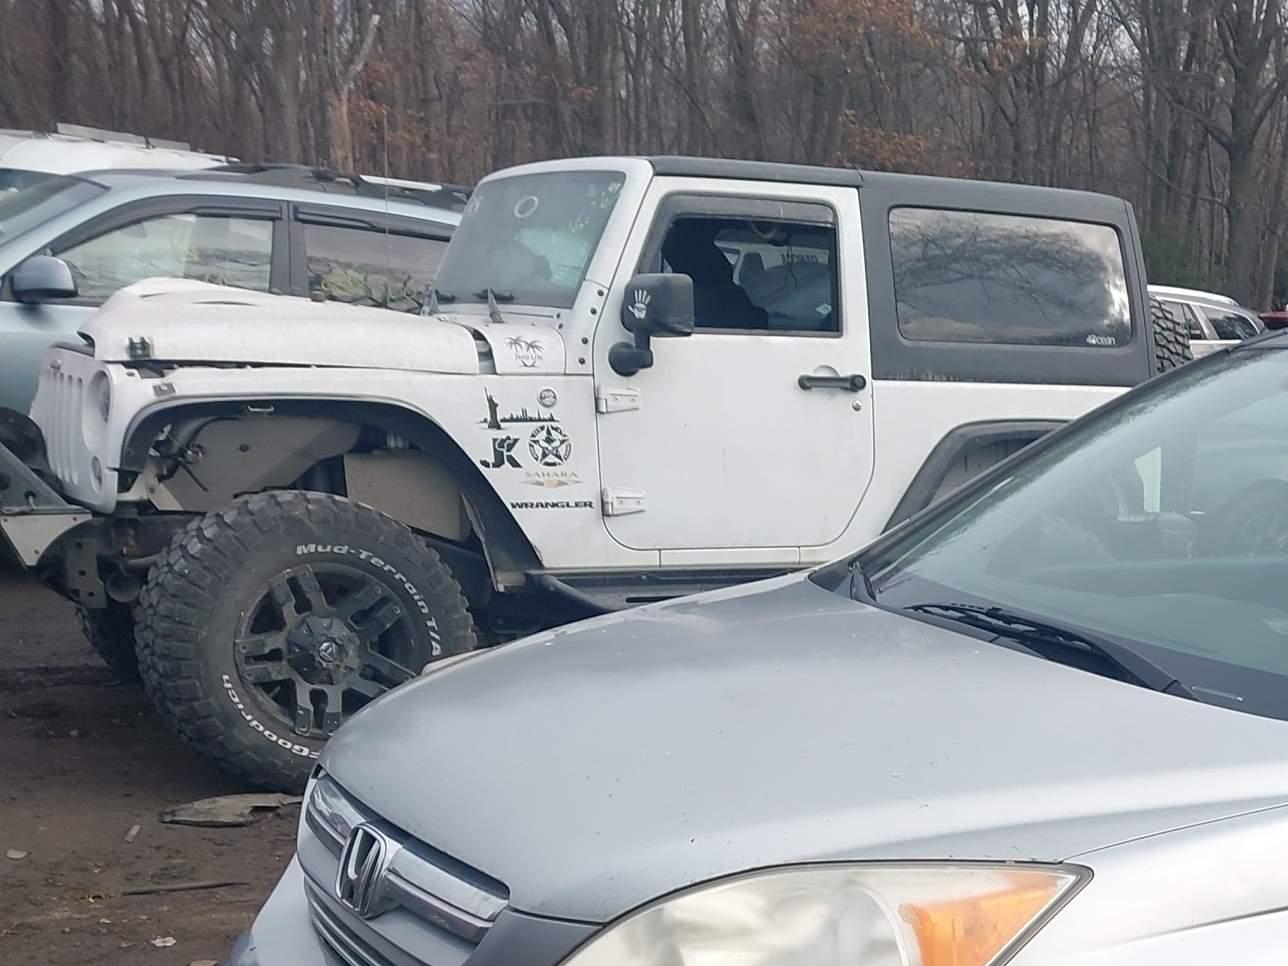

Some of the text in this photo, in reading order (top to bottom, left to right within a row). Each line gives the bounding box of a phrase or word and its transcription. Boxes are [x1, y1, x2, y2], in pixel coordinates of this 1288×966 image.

[479, 436, 523, 469] JK
[525, 470, 579, 479] SAHARA
[511, 500, 595, 509] WRANGLER
[296, 543, 442, 657] Mud-Terrain T/A
